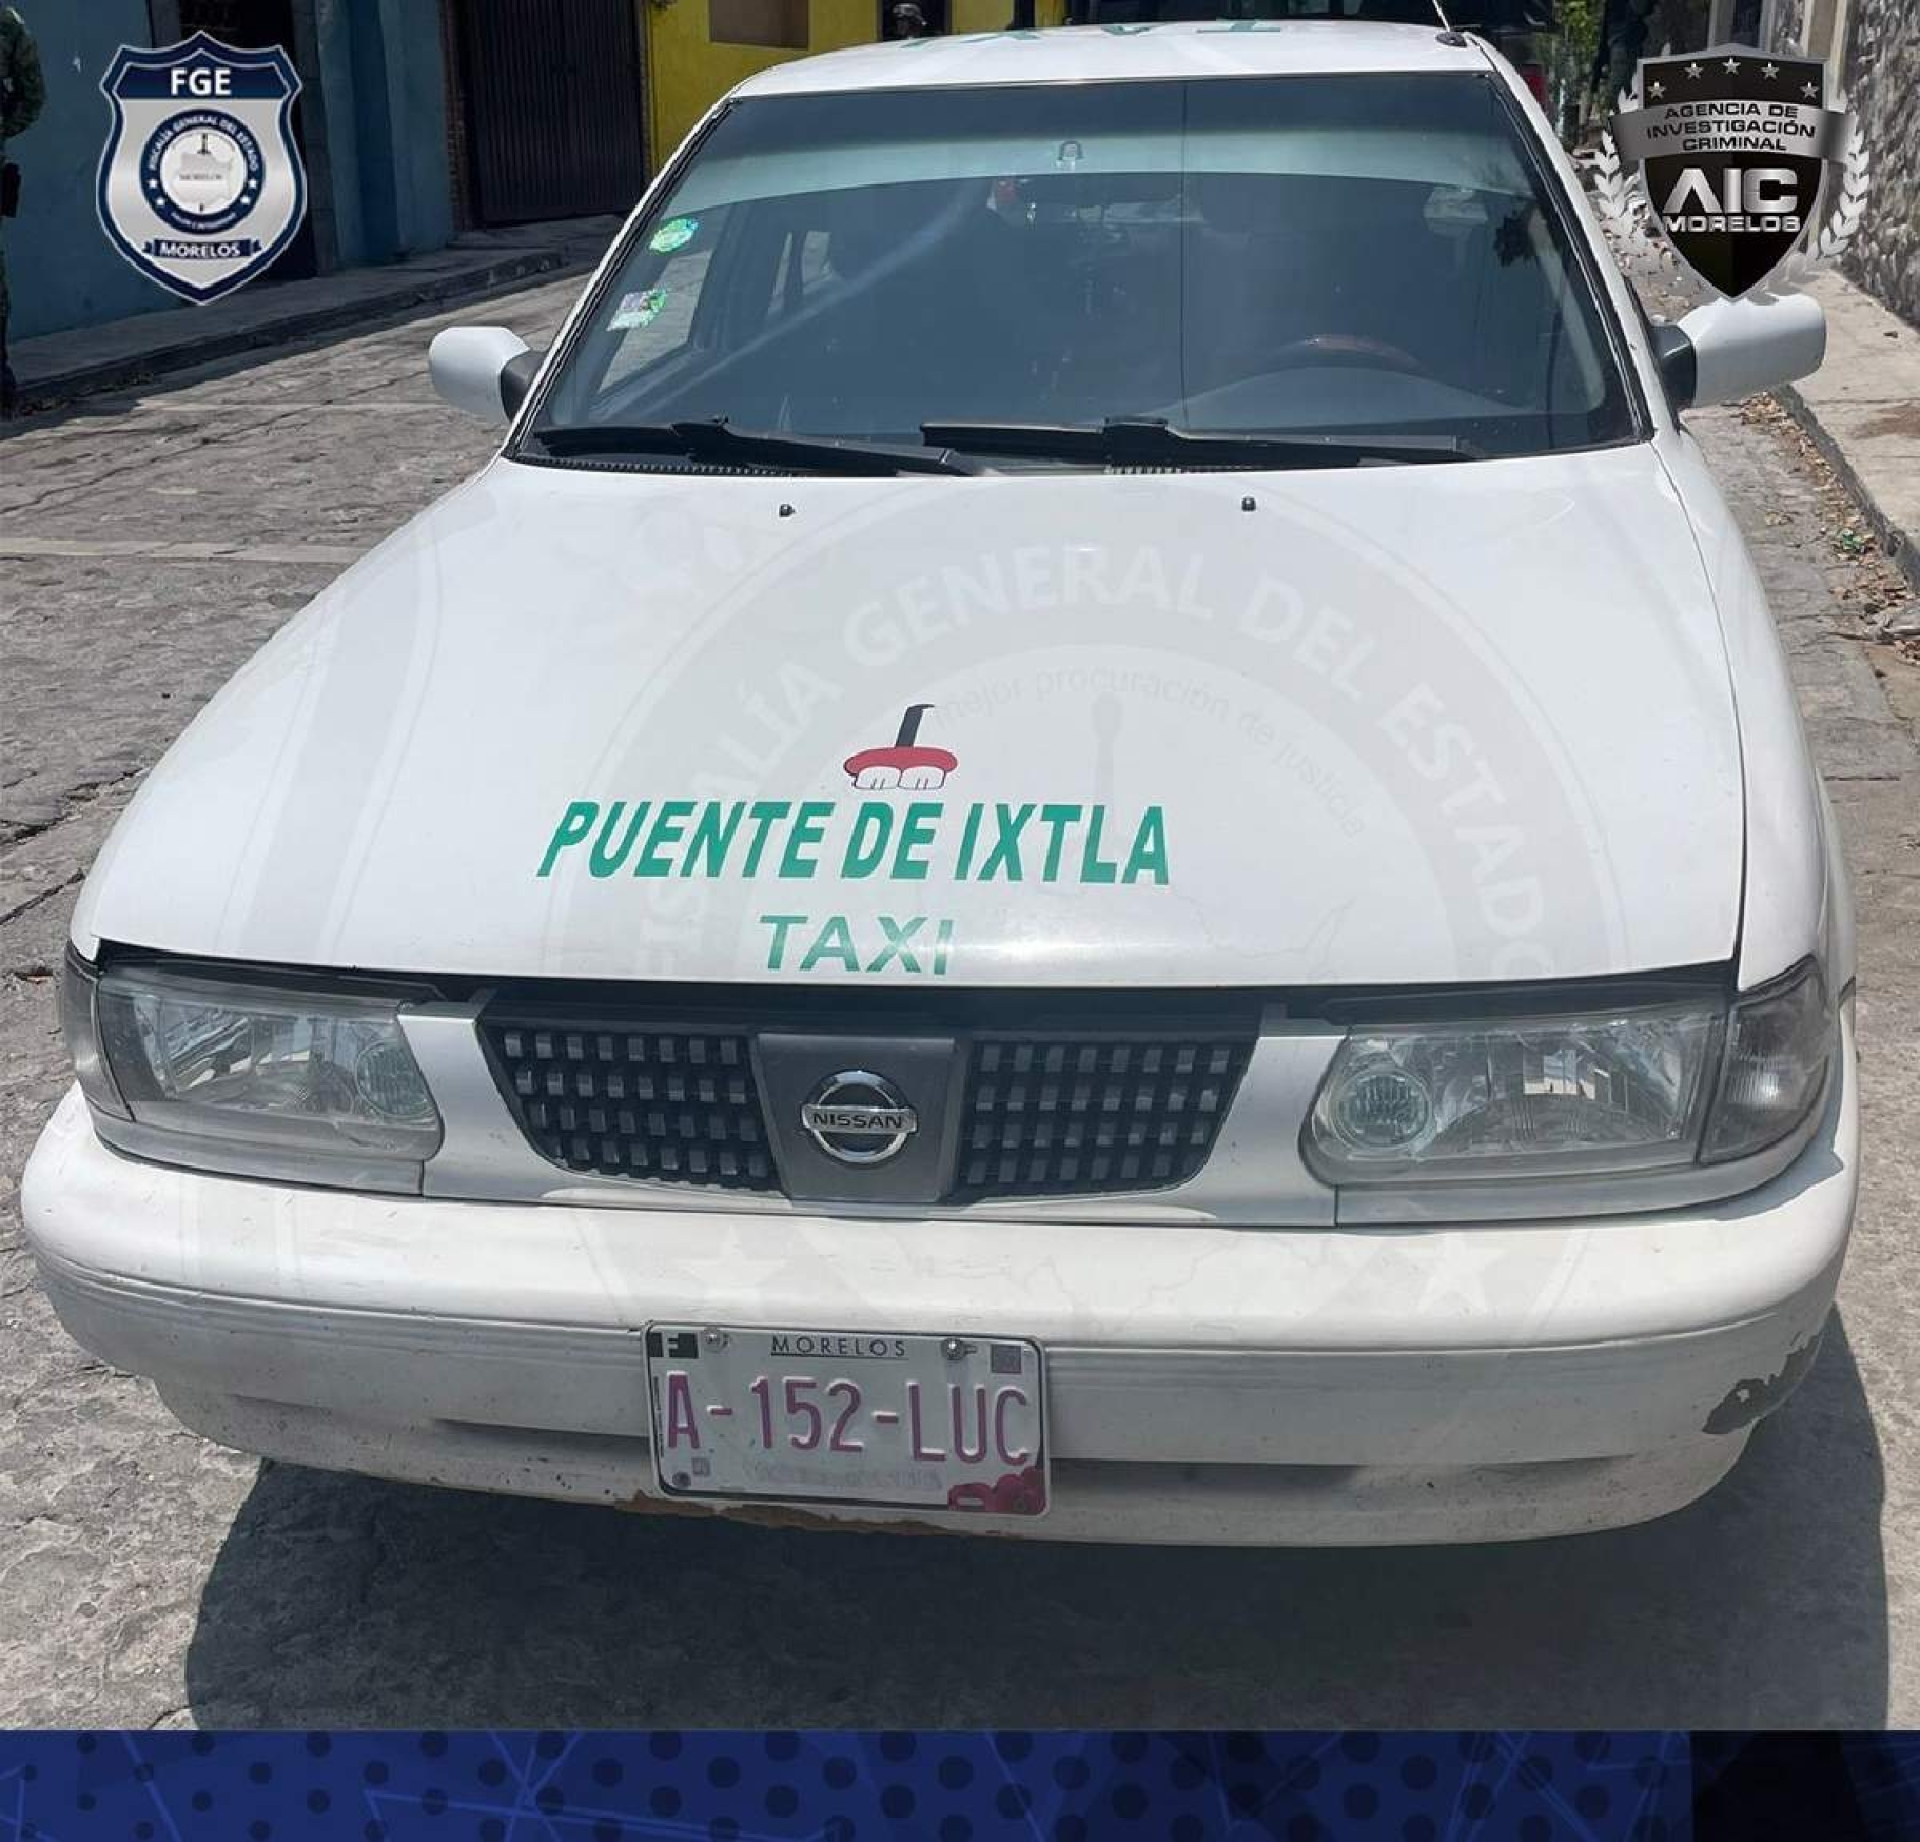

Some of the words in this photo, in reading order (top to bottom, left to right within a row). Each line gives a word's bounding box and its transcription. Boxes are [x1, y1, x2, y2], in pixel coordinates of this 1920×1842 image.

[536, 801, 836, 878] PUENTE
[840, 801, 945, 879] DE
[954, 802, 1169, 885] IXTLA
[760, 915, 955, 976] TAXI
[813, 1112, 902, 1129] NISSAN
[771, 1336, 907, 1357] MORELOS
[666, 1371, 1029, 1466] A-152-LUC
